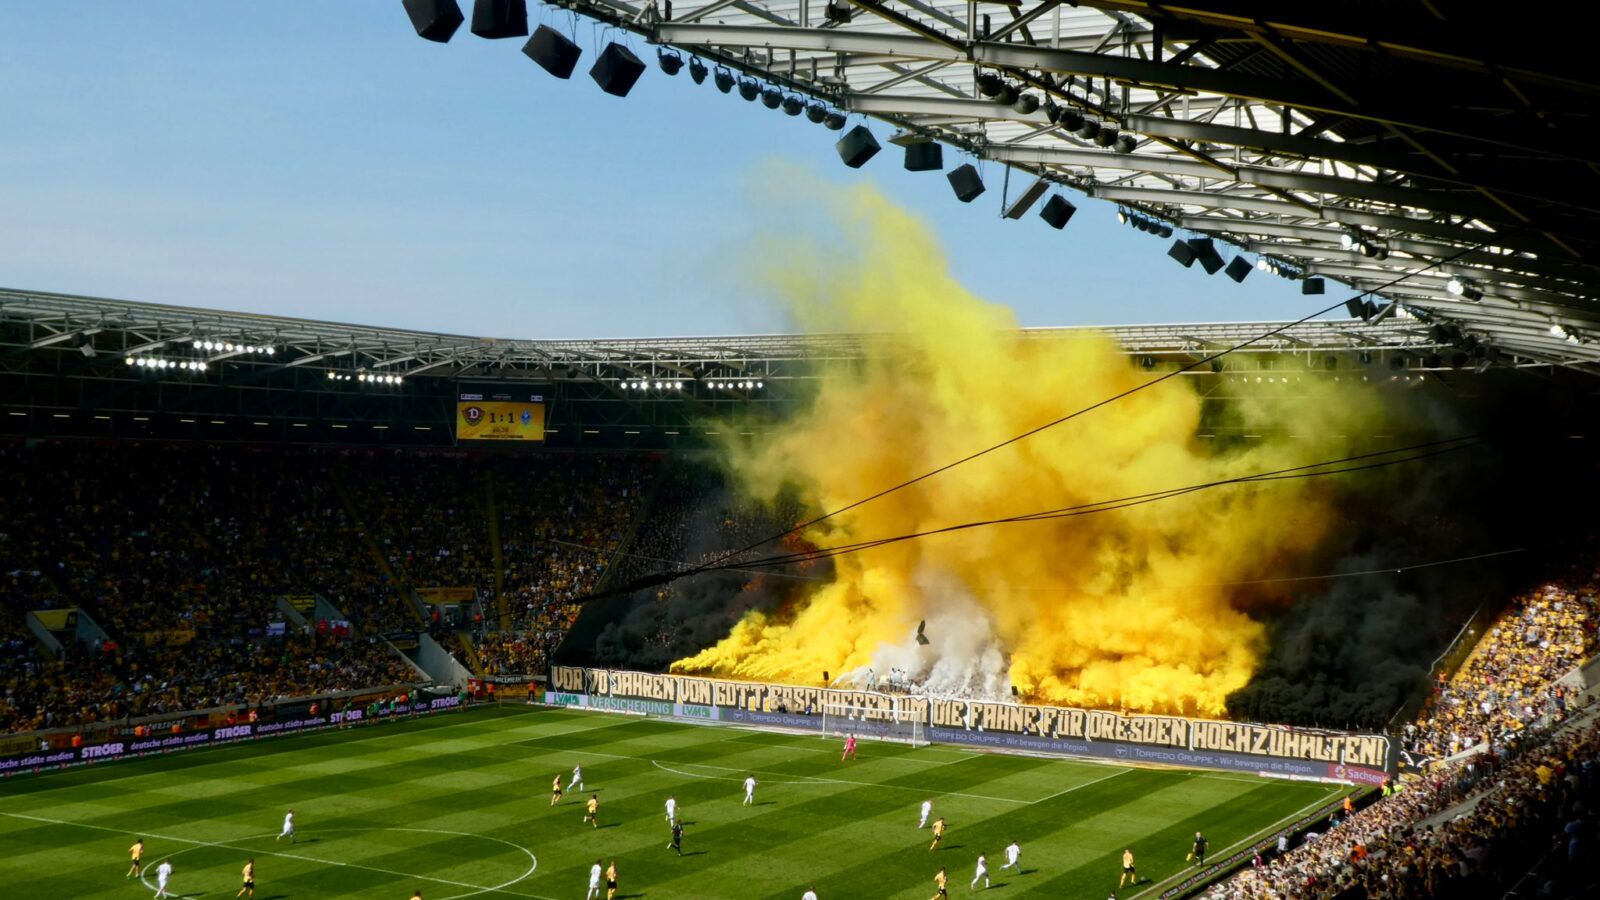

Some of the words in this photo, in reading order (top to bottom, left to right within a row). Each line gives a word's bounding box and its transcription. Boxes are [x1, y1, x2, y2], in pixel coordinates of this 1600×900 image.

[553, 666, 583, 690] VOR
[590, 669, 608, 694] 70
[612, 671, 675, 701] JAHREN
[679, 678, 711, 705] VON
[715, 682, 765, 711] GOTT
[899, 696, 928, 723] UM
[933, 699, 965, 726] DIE
[969, 702, 1039, 733] FAHNE
[1043, 707, 1084, 738] FÜR
[1089, 711, 1187, 747] DRESDEN
[1193, 721, 1385, 766] HOCHZUHALTEN!
[591, 697, 669, 714] VERSICHERUNG
[215, 724, 251, 740] STRÖER
[969, 732, 1000, 744] GRUPPE
[1006, 737, 1018, 746] Wir
[1019, 738, 1050, 750] bewegen
[1051, 740, 1062, 749] die
[1063, 741, 1088, 753] Region.
[81, 743, 124, 759] STRÖER
[131, 738, 161, 751] deutsche
[162, 735, 183, 747] städte
[184, 732, 209, 744] medien
[20, 754, 45, 767] städte
[46, 751, 75, 763] medien
[1177, 751, 1213, 764] GRUPPE
[1219, 756, 1233, 766] Wir
[1235, 758, 1269, 771] bewegen
[1271, 760, 1282, 770] die
[1284, 762, 1313, 774] Region.
